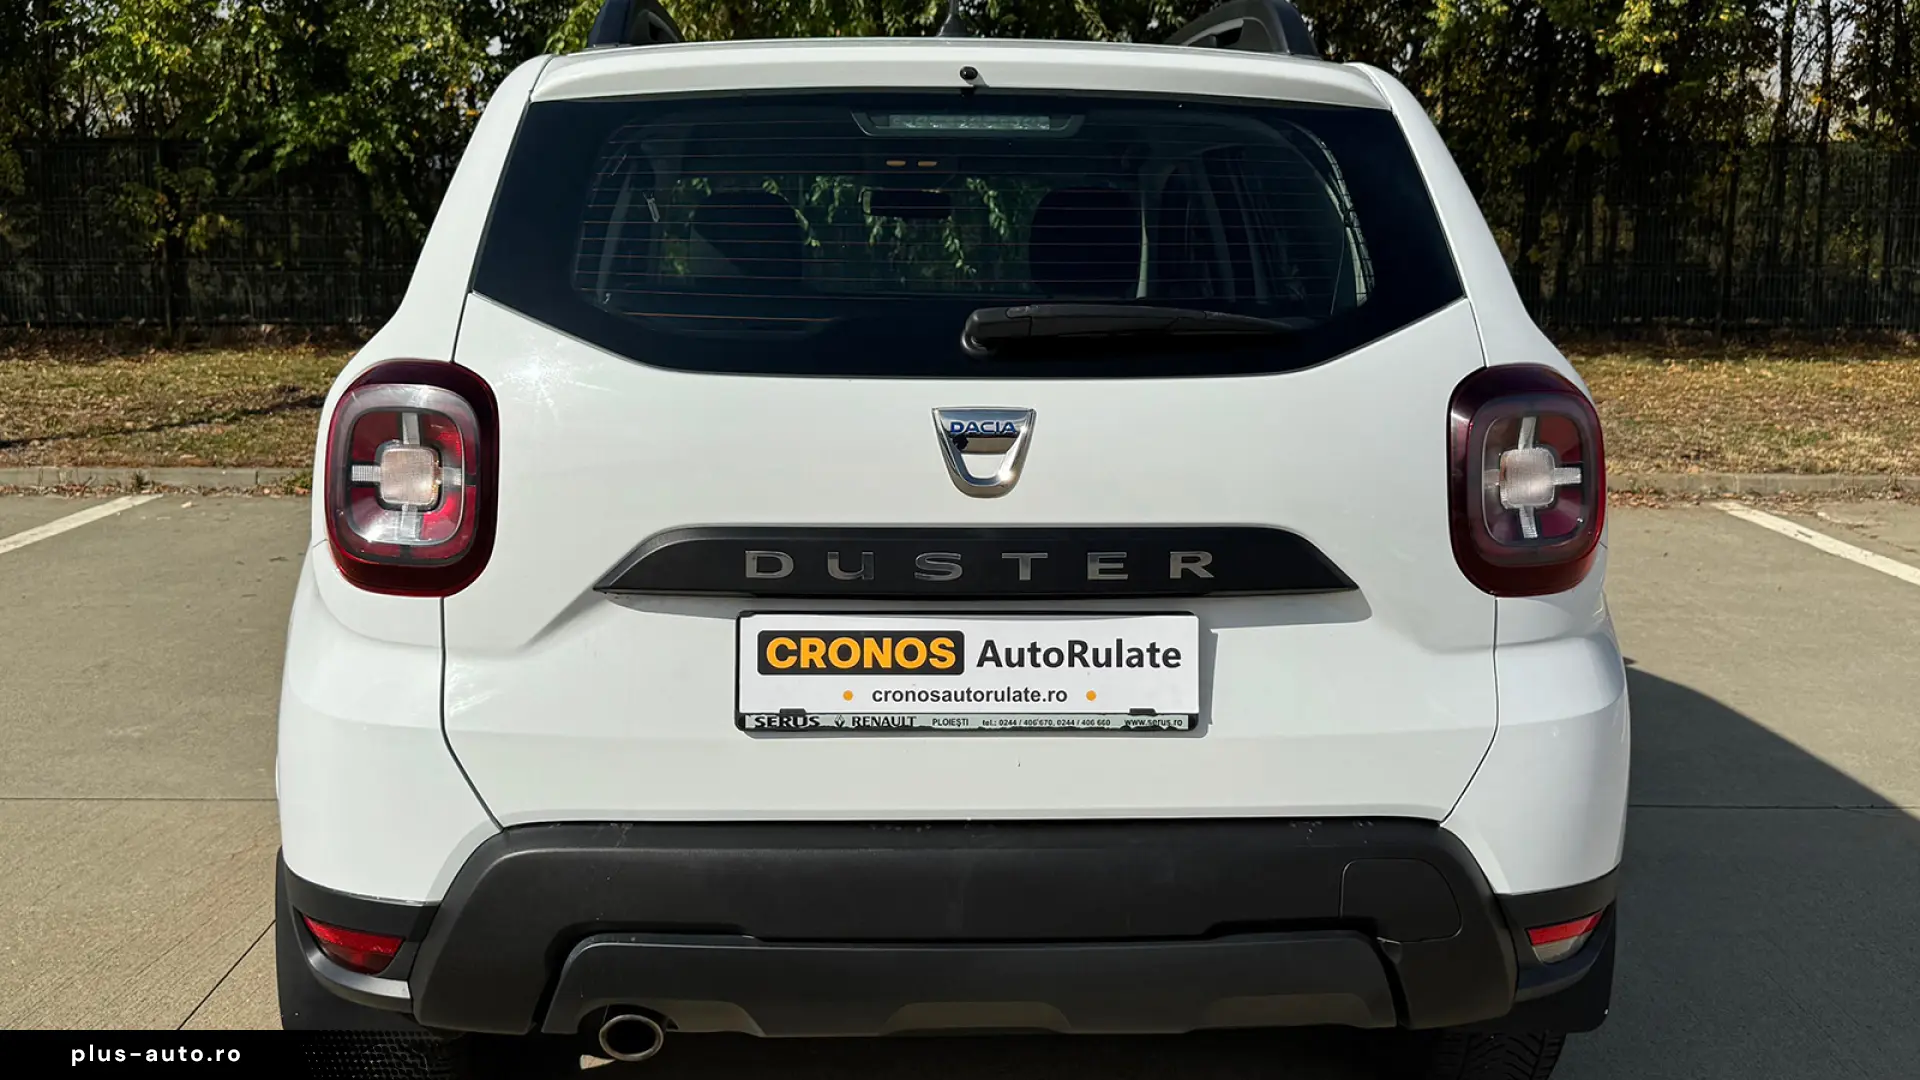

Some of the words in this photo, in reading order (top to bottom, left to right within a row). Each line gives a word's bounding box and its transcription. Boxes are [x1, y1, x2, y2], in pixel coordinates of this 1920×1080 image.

[950, 421, 1017, 433] DACIA
[744, 549, 1215, 582] DUSTER
[765, 636, 957, 670] CRONOS
[976, 638, 1183, 669] AutoRulate
[871, 686, 1068, 703] cronosautorulate.ro
[754, 715, 821, 728] SERUS
[851, 715, 918, 728] RENAULT
